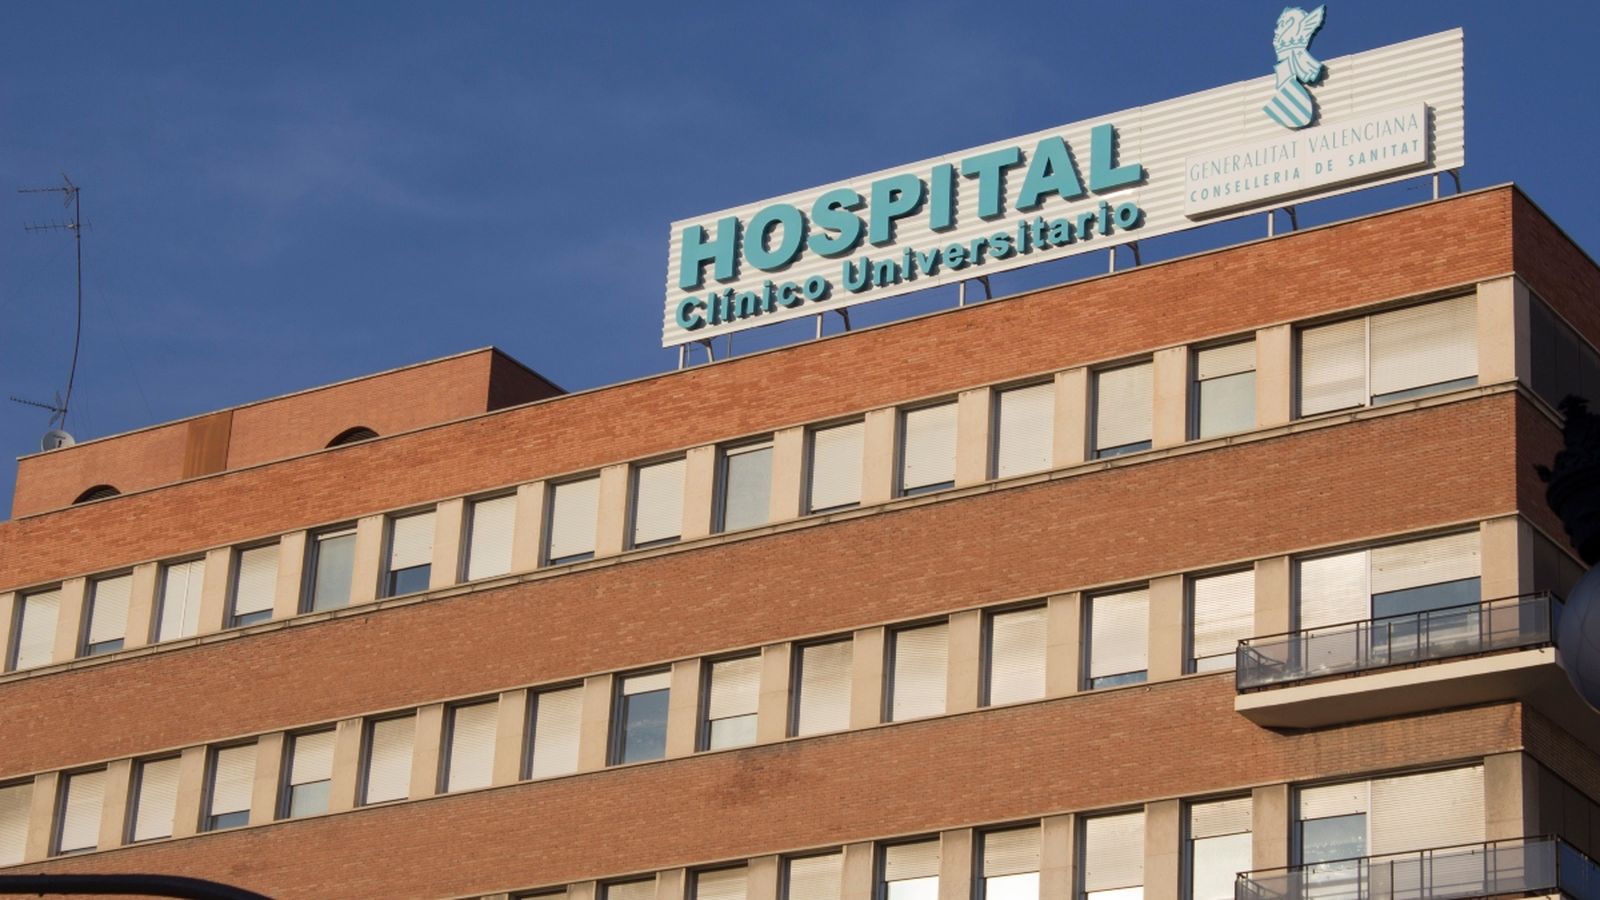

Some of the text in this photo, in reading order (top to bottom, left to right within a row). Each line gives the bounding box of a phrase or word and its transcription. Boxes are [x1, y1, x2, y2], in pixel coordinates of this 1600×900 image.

[1190, 113, 1418, 181] GENERALITAT VALENCIANA
[1190, 139, 1418, 202] CONSELLERIA DE SANITAT
[679, 123, 1143, 290] HOSPITAL
[675, 200, 1140, 330] Clínico Universitario
